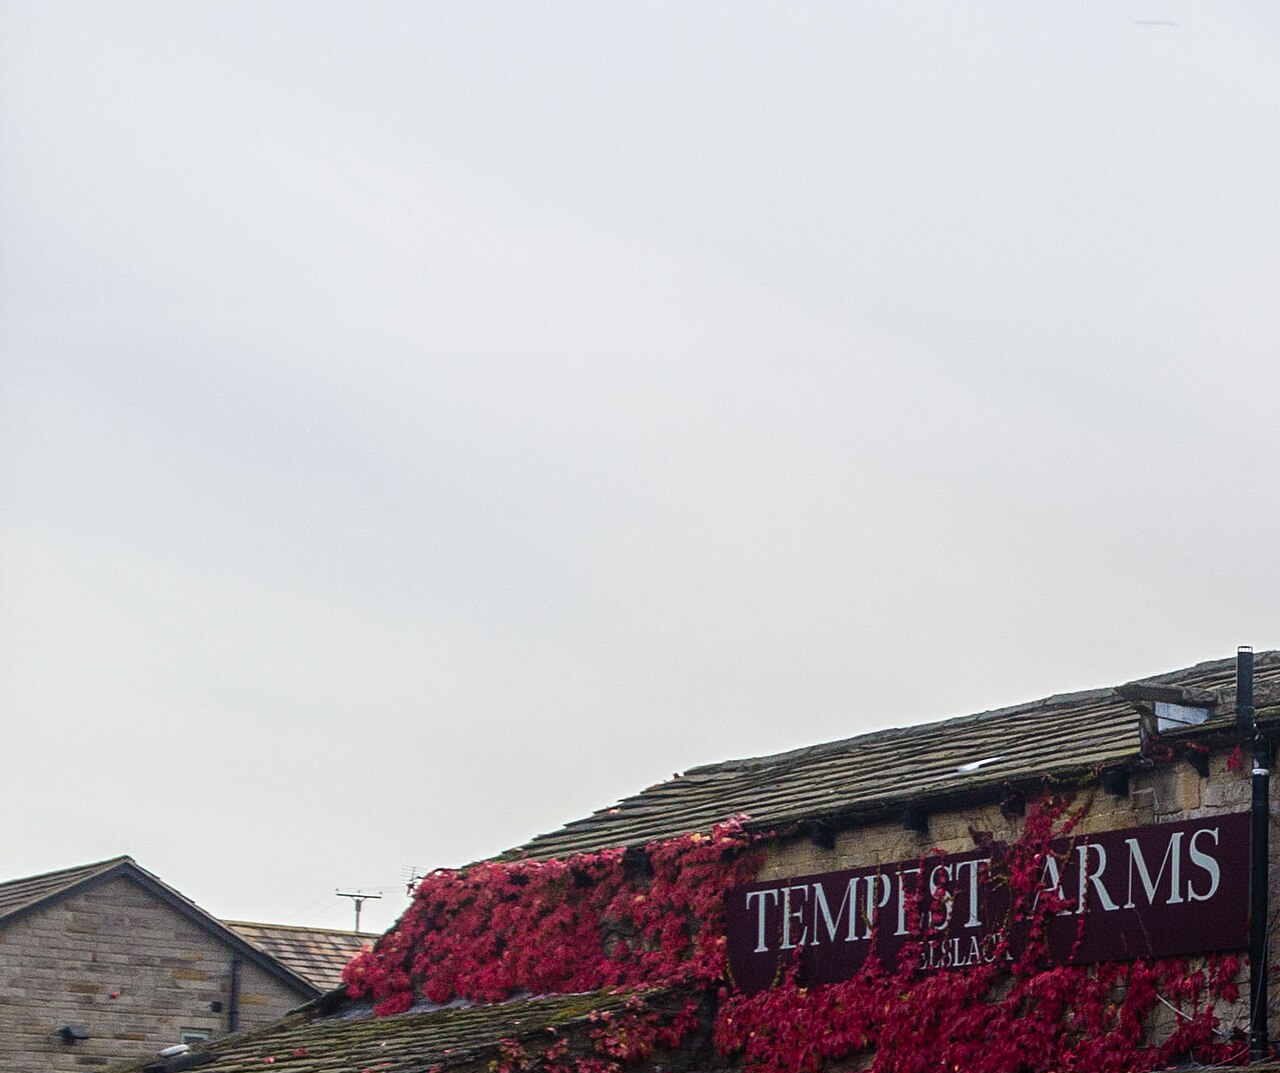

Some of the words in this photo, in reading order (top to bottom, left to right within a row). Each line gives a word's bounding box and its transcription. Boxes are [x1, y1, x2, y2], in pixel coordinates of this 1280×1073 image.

[746, 857, 992, 953] TEMPEST
[1026, 827, 1221, 920] ARMS
[919, 933, 1014, 970] ELSLAC
